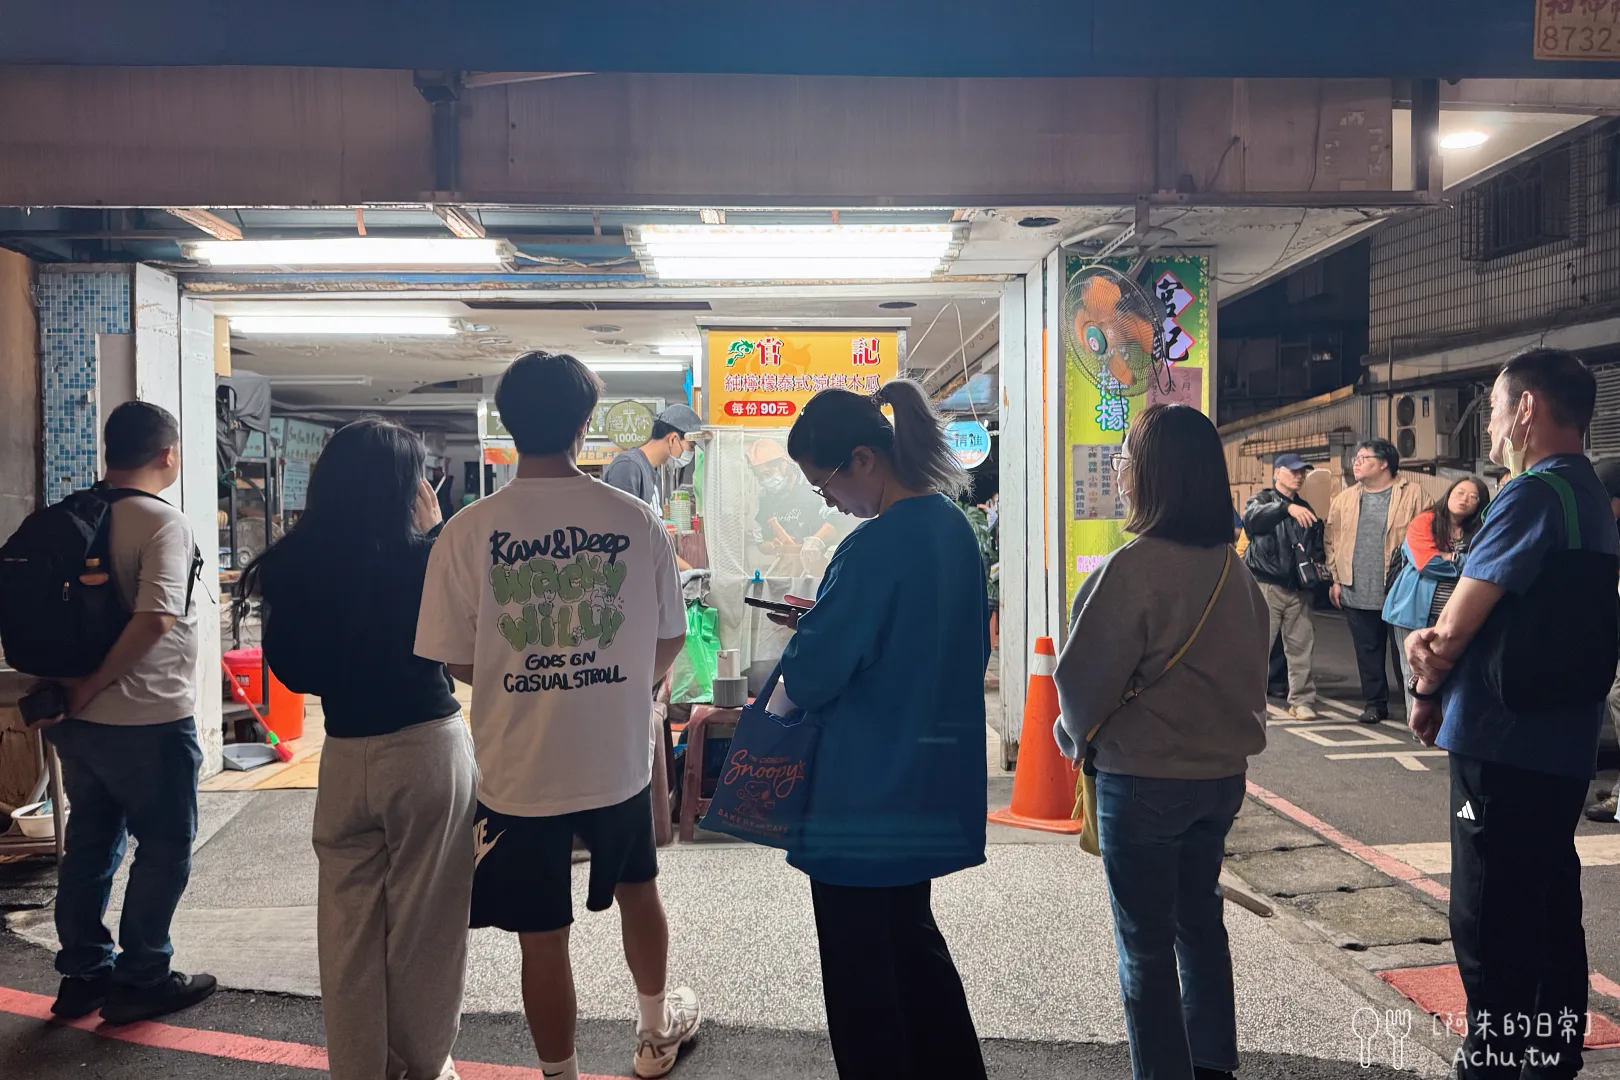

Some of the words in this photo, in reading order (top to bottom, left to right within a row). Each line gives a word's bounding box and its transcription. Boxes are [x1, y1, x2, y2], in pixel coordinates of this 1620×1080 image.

[731, 402, 790, 416] 每份90元
[614, 432, 646, 444] 1000cc
[489, 526, 631, 566] Raw&Deep
